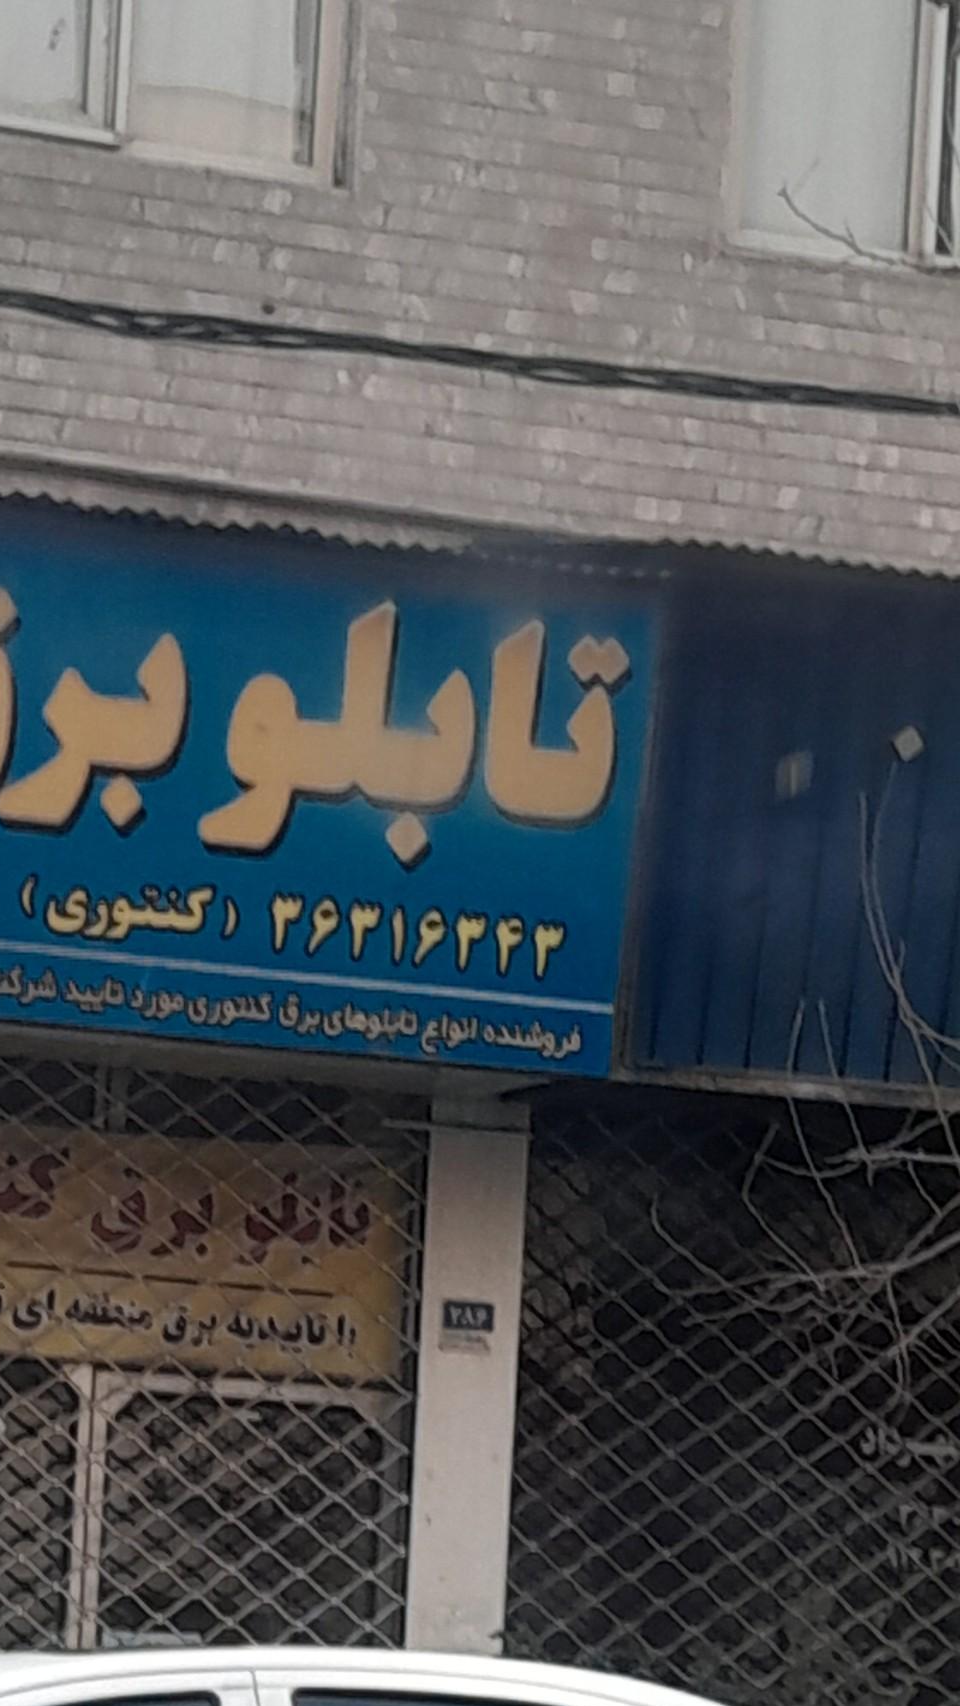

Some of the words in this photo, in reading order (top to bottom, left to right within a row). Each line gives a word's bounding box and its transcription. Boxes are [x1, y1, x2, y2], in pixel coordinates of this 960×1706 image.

[198, 598, 631, 866] تابلو
[271, 891, 566, 981] ۳۶۳۱۶۳۴۳
[64, 975, 125, 1014] تایید
[128, 984, 185, 1020] مورد
[187, 990, 274, 1027] کنتوری
[278, 992, 321, 1036] برق
[322, 1002, 418, 1041] تابلوهای
[420, 1012, 478, 1055] انواع
[482, 1021, 582, 1060] فروشنده
